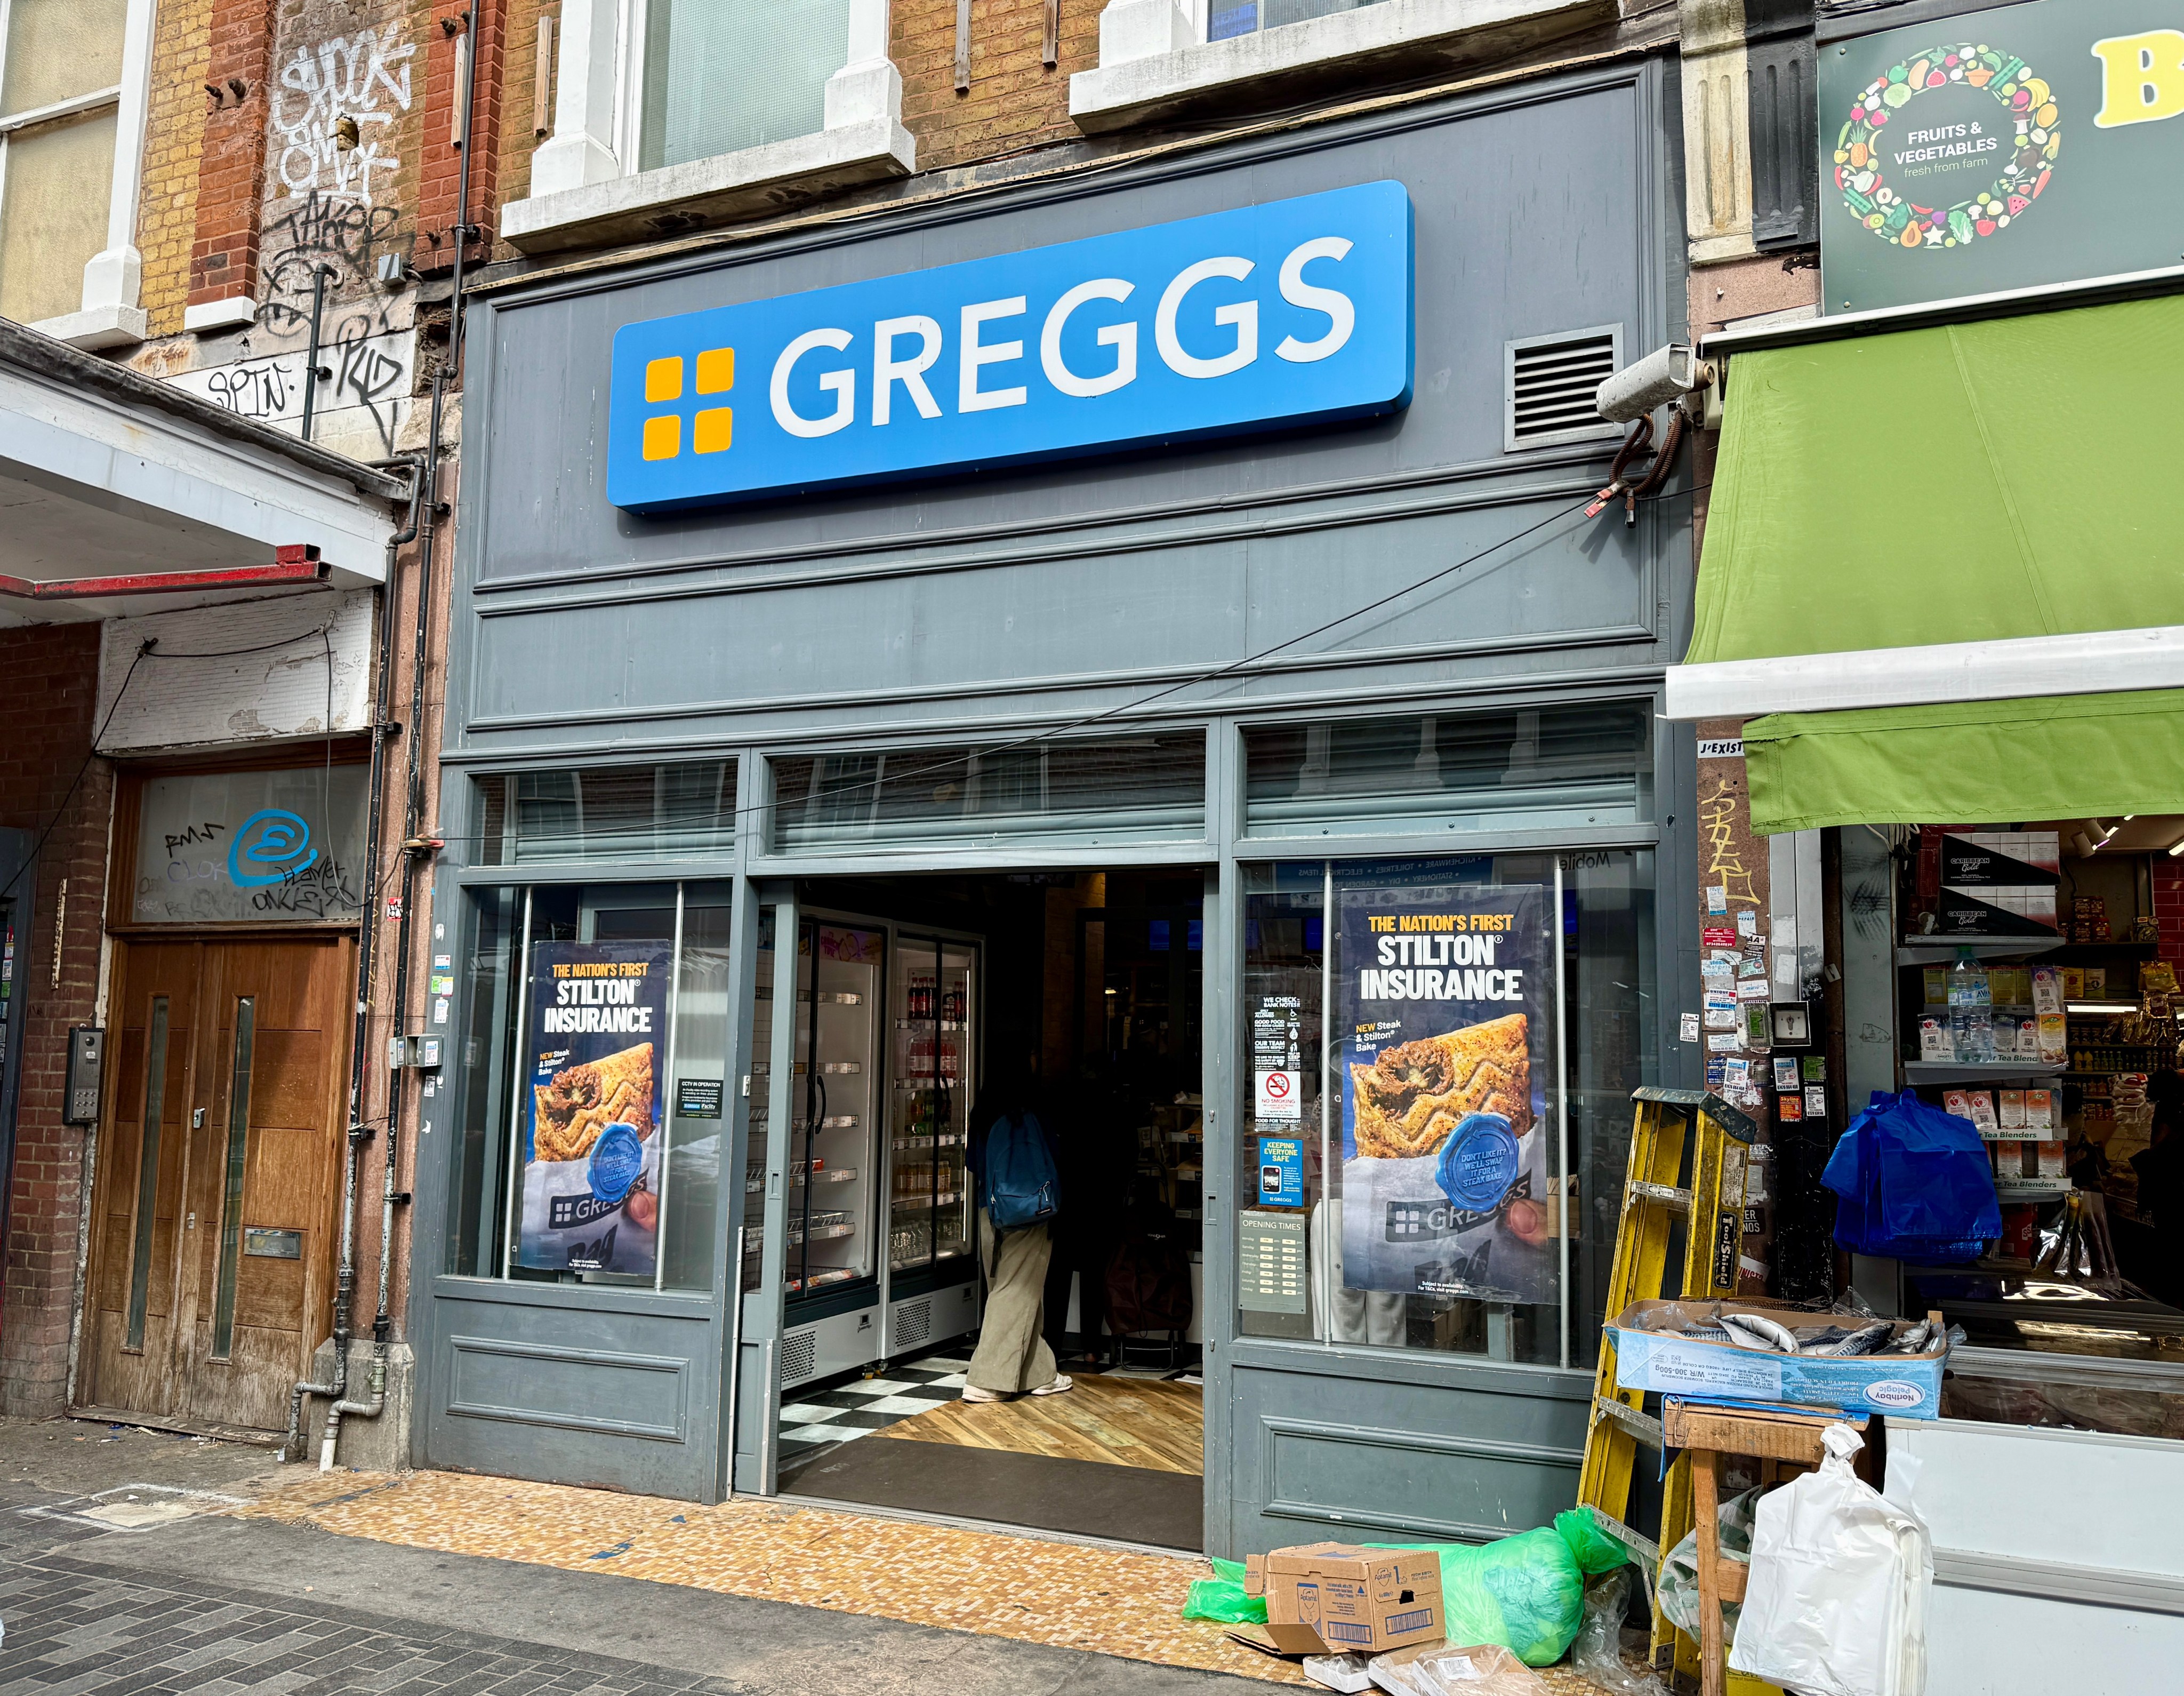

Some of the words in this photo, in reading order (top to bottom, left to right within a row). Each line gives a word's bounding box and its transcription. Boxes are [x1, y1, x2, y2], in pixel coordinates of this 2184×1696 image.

[2091, 29, 2184, 128] B
[1908, 124, 1966, 145] FRUITS
[1970, 122, 1982, 134] &
[1894, 137, 1997, 165] VEGETABLES
[1904, 165, 1931, 178] fresh
[1934, 163, 1959, 173] from
[1963, 158, 1987, 168] farm
[770, 237, 1355, 438] GREGGS
[1700, 742, 1745, 754] J'EXIST
[1962, 863, 1979, 873] Gold
[1368, 915, 1396, 932] THE
[1400, 915, 1467, 932] NATION'S
[1470, 914, 1514, 931] FIRST
[1958, 916, 1977, 925] Gold
[552, 964, 571, 978] THE
[572, 963, 617, 977] NATION'S
[619, 963, 649, 977] FIRST
[1361, 969, 1523, 1001] INSURANCE
[544, 1007, 653, 1033] INSURANCE
[1356, 1023, 1376, 1033] NEW
[1377, 1020, 1401, 1031] Steak
[1356, 1043, 1377, 1052] Bake
[540, 1052, 553, 1060] NEW
[553, 1049, 569, 1058] Steak
[617, 1153, 627, 1161] LIKE
[1461, 1153, 1481, 1163] DON'T
[1482, 1150, 1496, 1159] LIKE
[1496, 1149, 1506, 1157] IT?
[620, 1158, 631, 1166] SWAP
[1464, 1162, 1485, 1171] WE'LL
[1485, 1157, 1503, 1166] SWAP
[1478, 1168, 1491, 1177] FOR
[604, 1174, 619, 1183] STEAK
[1462, 1178, 1484, 1187] STEAK
[1485, 1173, 1503, 1183] BAKE
[1743, 1210, 1756, 1220] ER
[1243, 1220, 1276, 1229] OPENING
[1279, 1222, 1301, 1230] TIMES
[1655, 1365, 1688, 1375] 300-500g
[1690, 1370, 1705, 1378] W/R
[1878, 1386, 1910, 1394] Pelagic
[1875, 1392, 1914, 1401] Northbay
[1375, 1572, 1392, 1581] Aptamil
[1300, 1594, 1318, 1602] Aptamil
